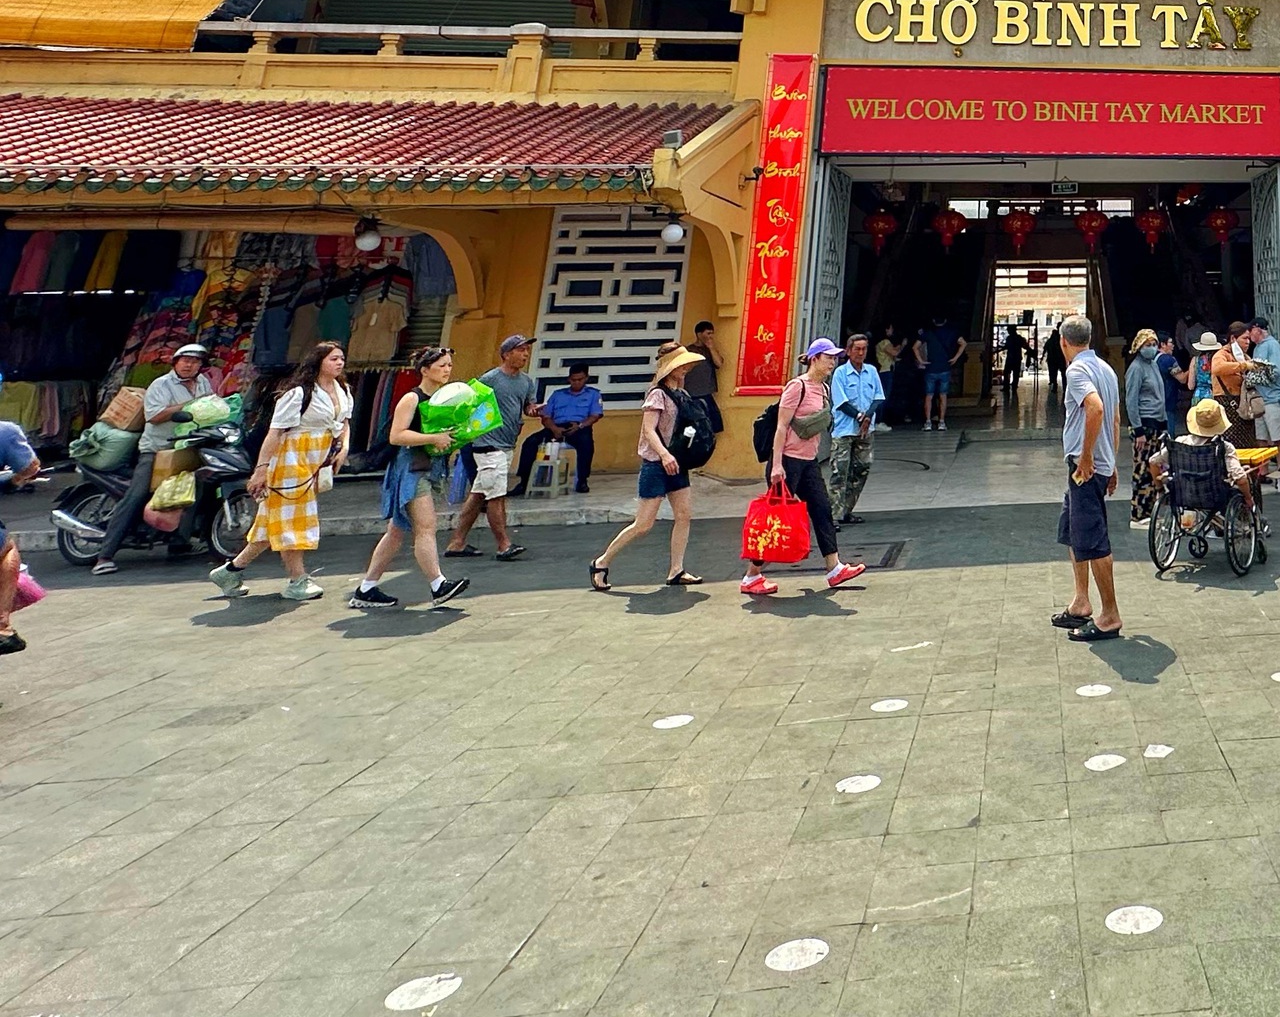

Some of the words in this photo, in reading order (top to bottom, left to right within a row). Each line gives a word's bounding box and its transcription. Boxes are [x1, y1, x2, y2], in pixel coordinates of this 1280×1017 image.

[846, 97, 985, 121] WELCOME
[992, 100, 1027, 122] TO
[1033, 101, 1098, 123] BINH
[1105, 102, 1155, 124] TAY
[1159, 103, 1266, 125] MARKET
